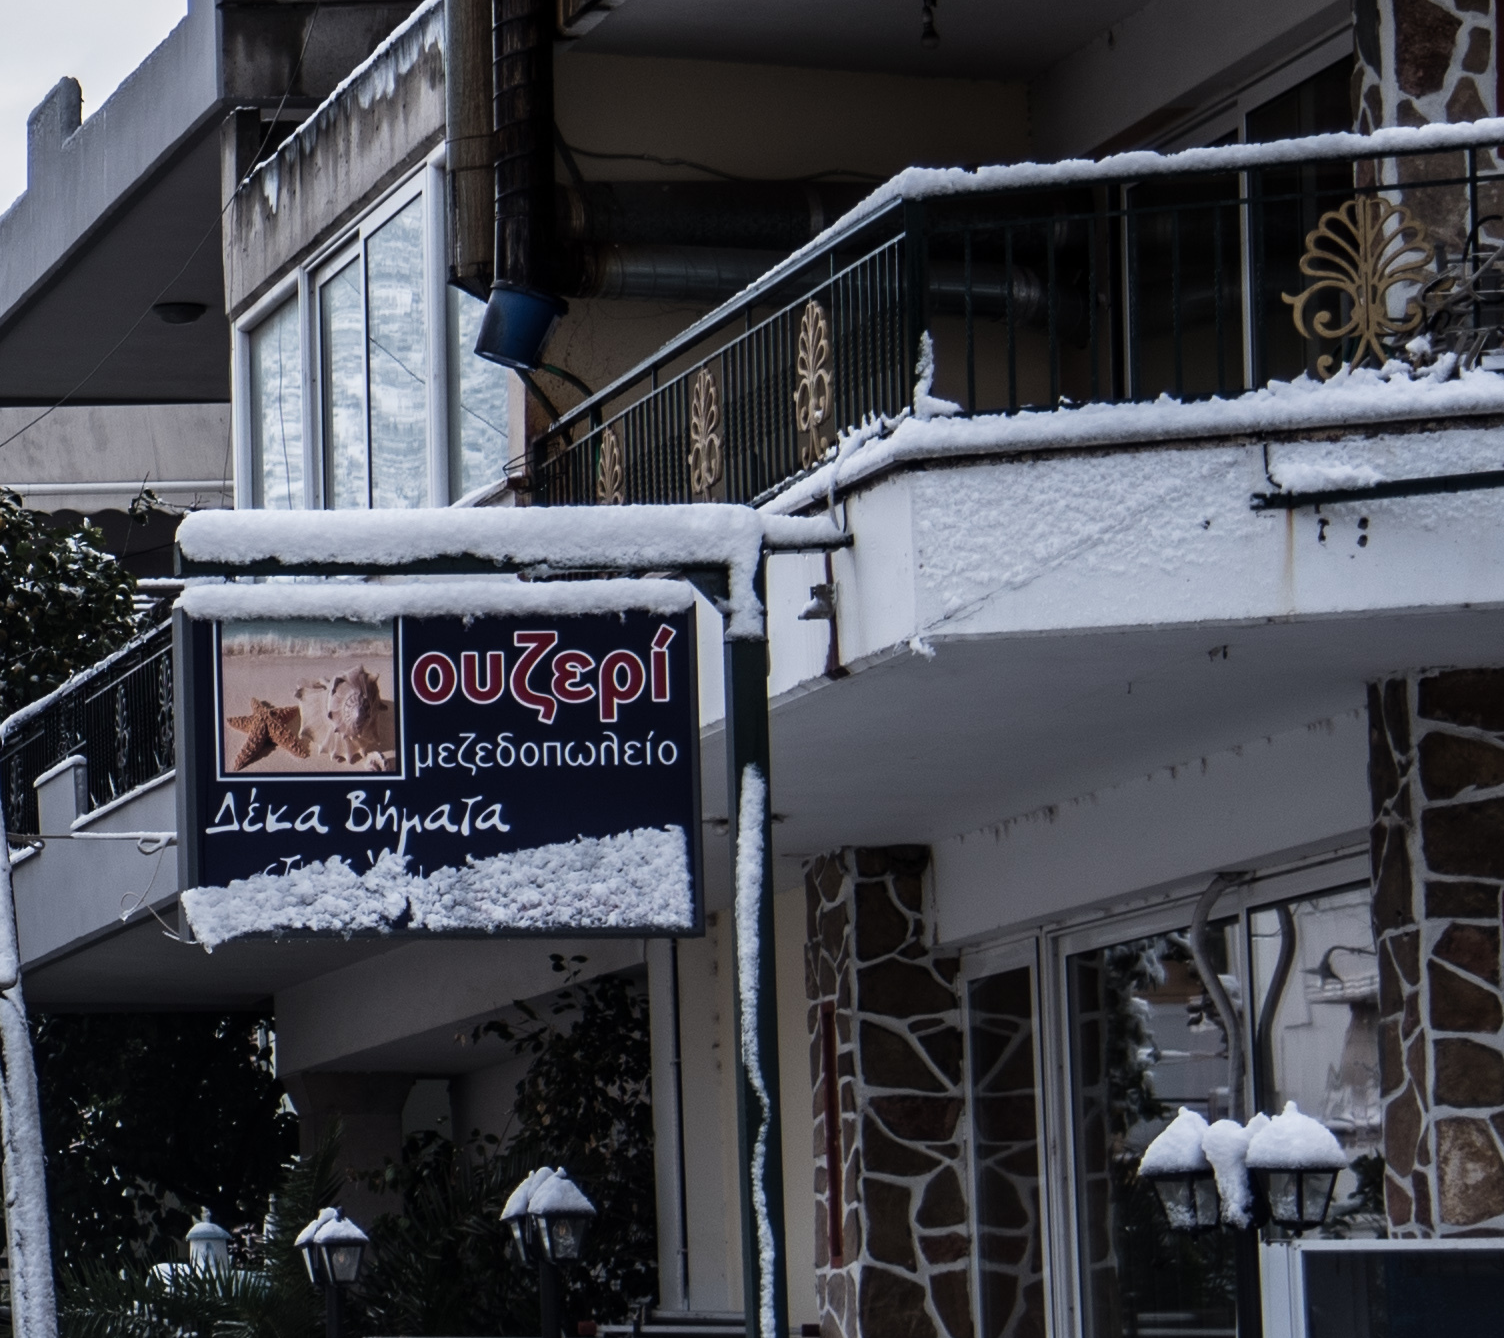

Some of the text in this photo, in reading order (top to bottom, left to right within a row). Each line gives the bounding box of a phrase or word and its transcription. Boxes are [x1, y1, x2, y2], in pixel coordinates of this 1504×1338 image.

[411, 624, 676, 723] ουζερί
[414, 730, 678, 777] μεζεδοπωλείο
[205, 788, 510, 857] Δέκα Βήματα
